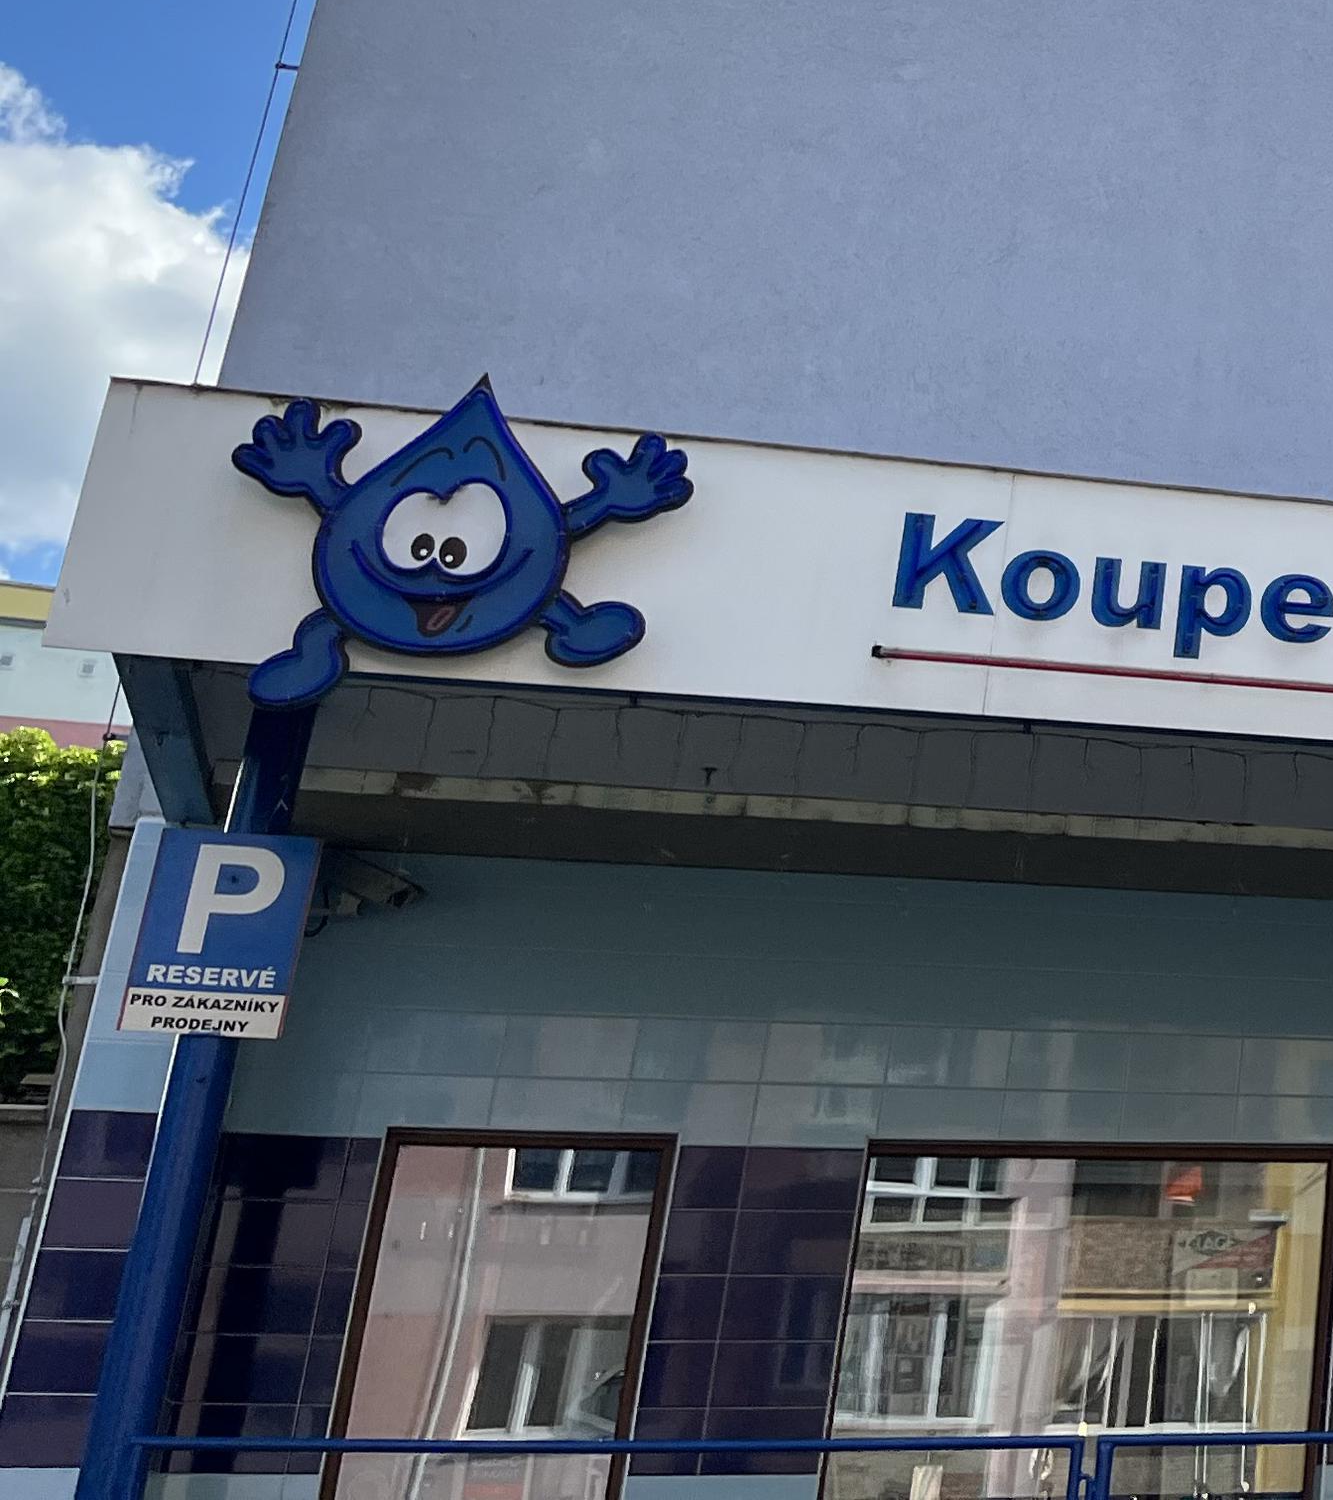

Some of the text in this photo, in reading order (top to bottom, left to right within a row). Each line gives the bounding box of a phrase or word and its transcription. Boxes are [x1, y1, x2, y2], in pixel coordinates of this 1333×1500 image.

[177, 844, 285, 954] P
[146, 964, 276, 988] RESERVÉ
[130, 994, 279, 1013] PRO ZÁKAZNÍKY
[151, 1016, 249, 1032] PRODEJNY
